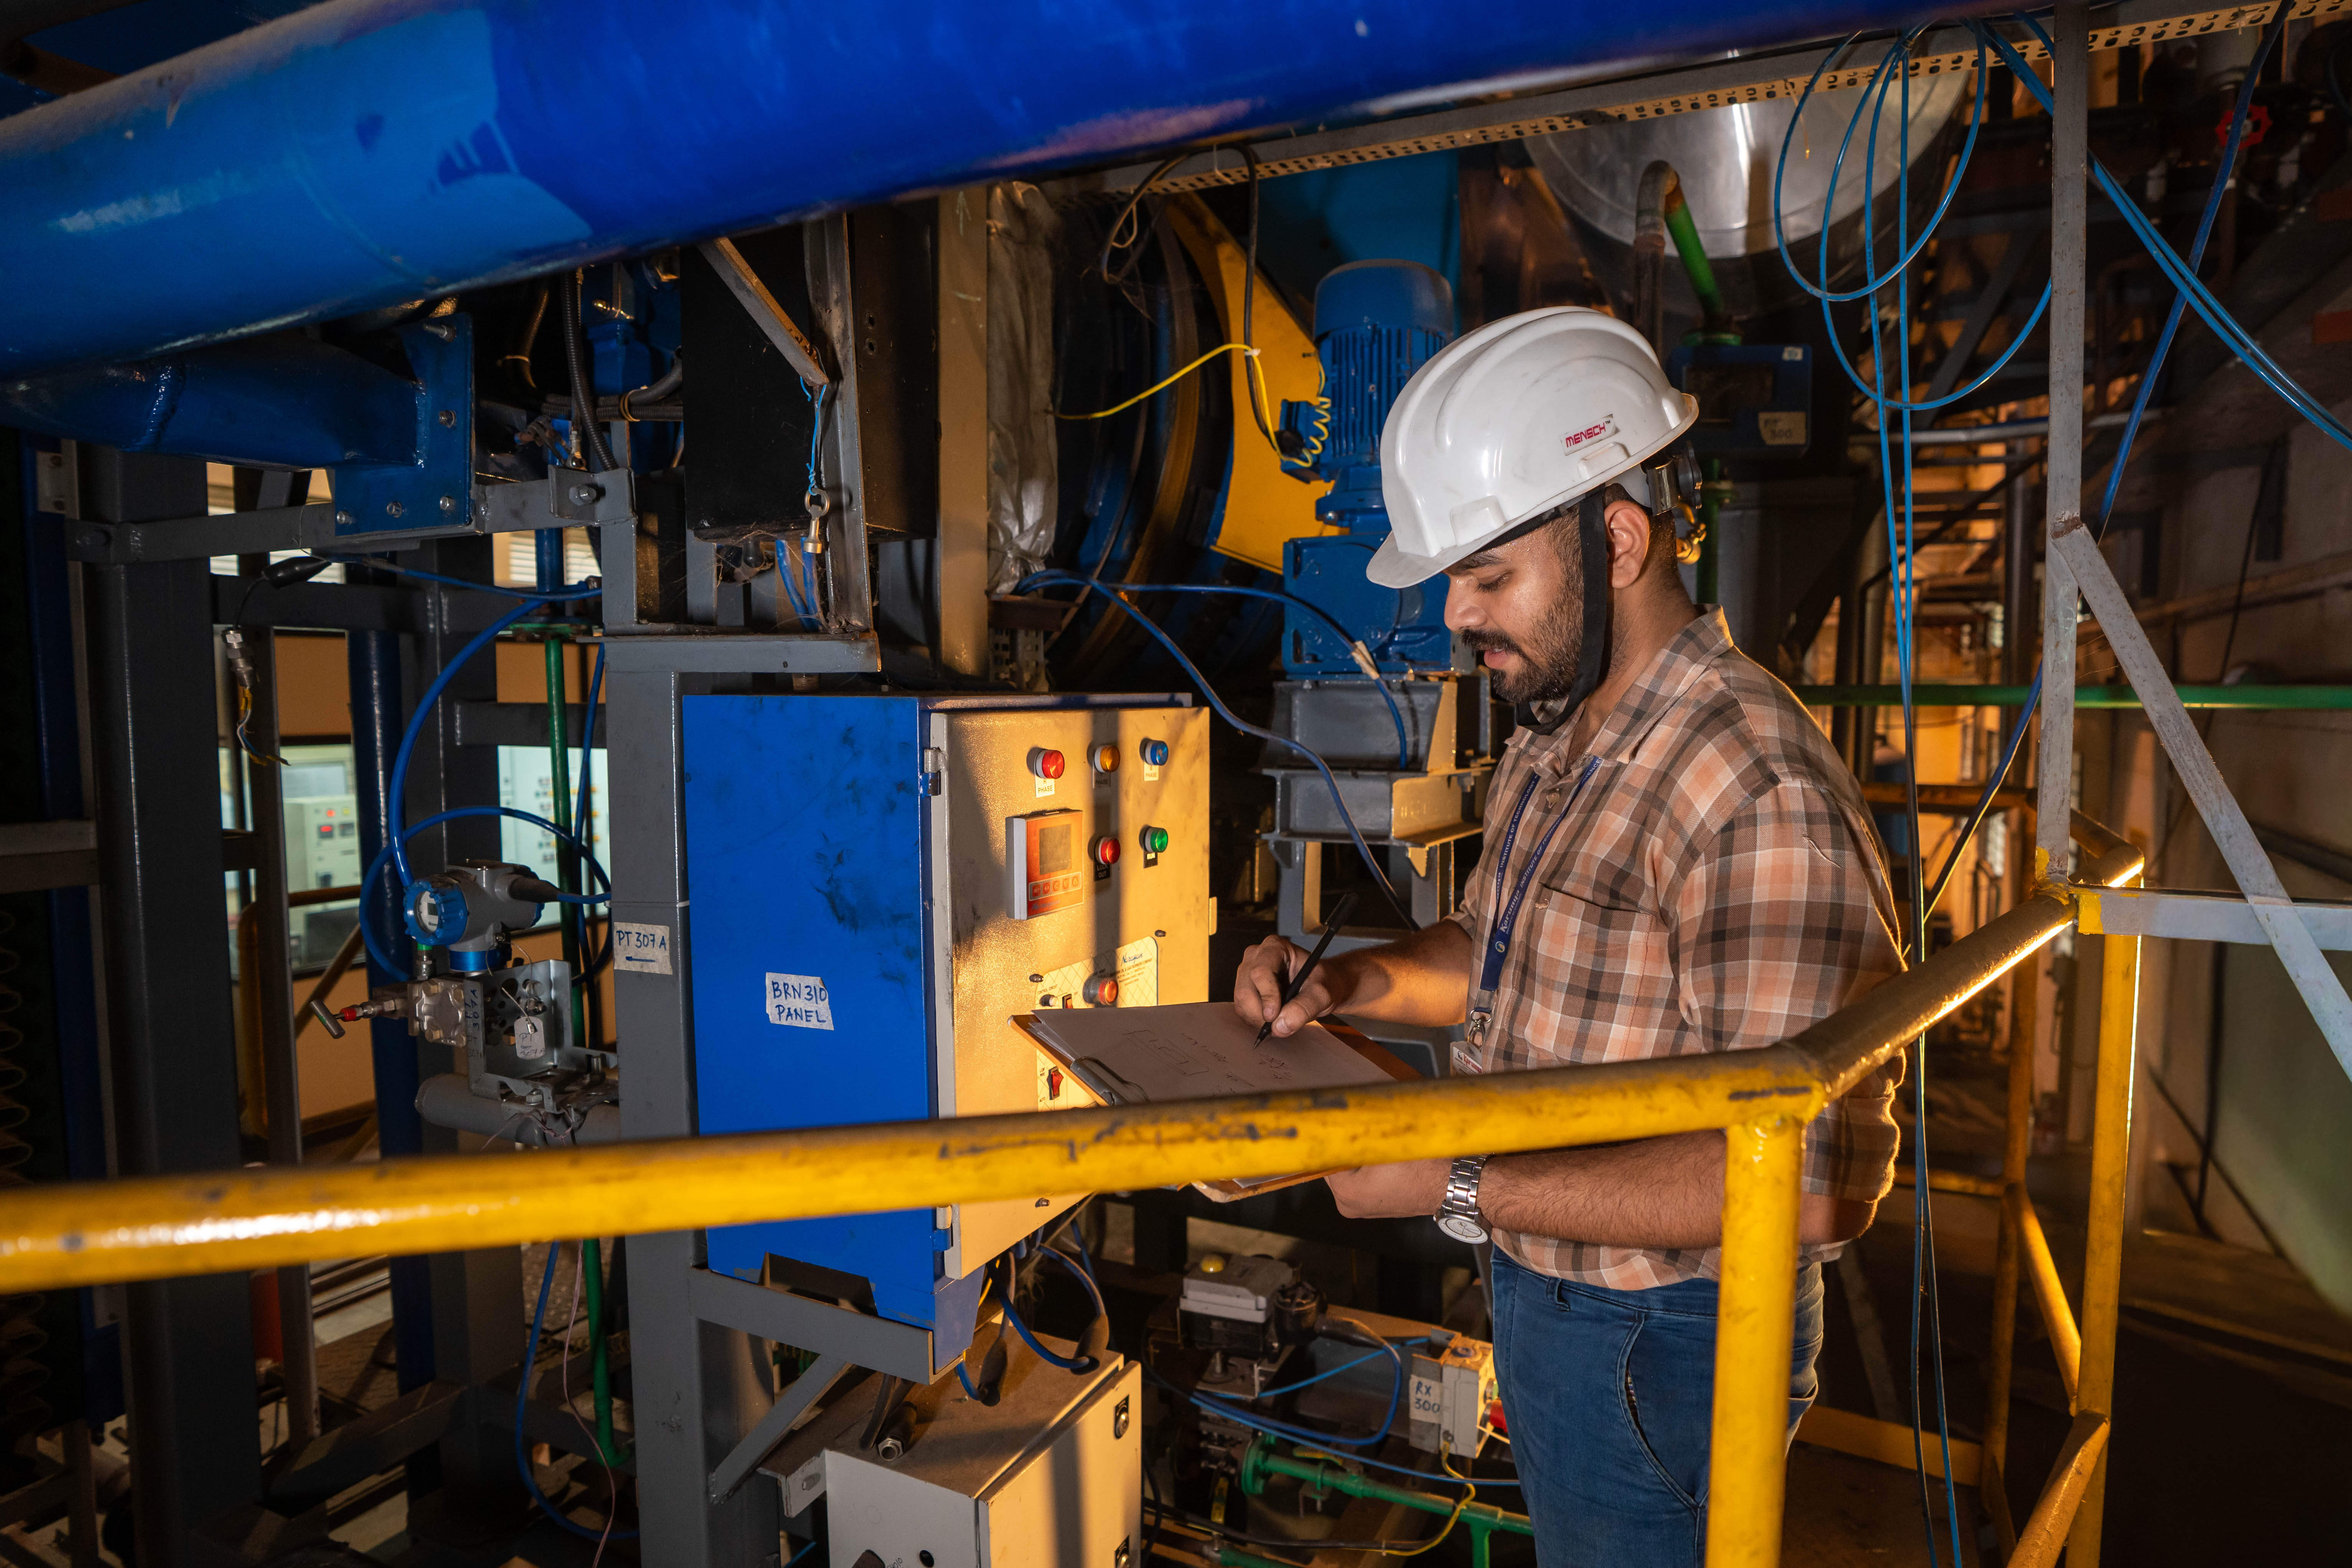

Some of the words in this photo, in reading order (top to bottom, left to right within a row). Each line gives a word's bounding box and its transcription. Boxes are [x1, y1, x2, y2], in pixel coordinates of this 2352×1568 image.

[1565, 422, 1606, 448] MENSCH
[1581, 757, 1602, 782] CIENCE
[1038, 785, 1053, 794] PHASE
[1500, 834, 1513, 867] INSTITUTE
[1510, 824, 1515, 833] OF
[1513, 781, 1535, 821] TECHNOLOGY
[1500, 890, 1520, 932] Karunya
[1520, 856, 1538, 888] INSTITUTE
[1537, 846, 1542, 854] OF
[616, 930, 632, 946] PT
[771, 980, 801, 1000] BRN
[775, 1004, 826, 1023] PANEL
[1416, 1381, 1432, 1397] RX
[1414, 1399, 1441, 1413] 300
